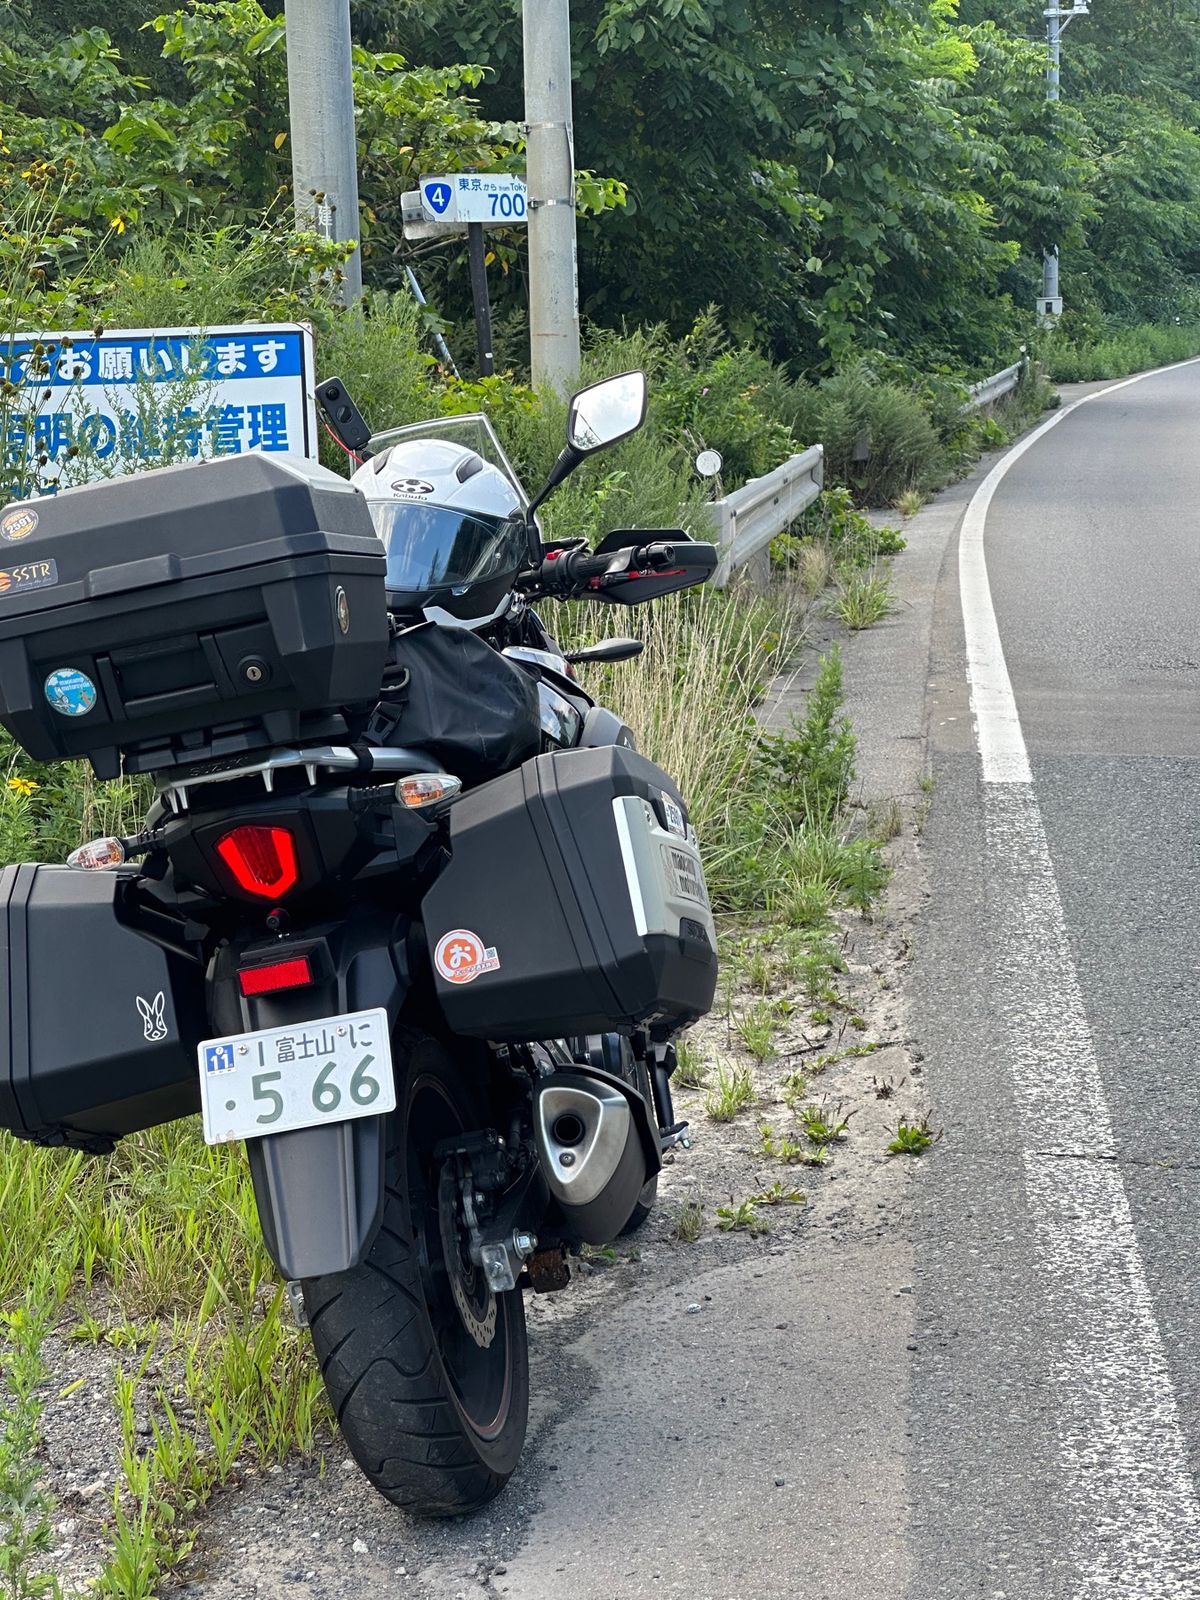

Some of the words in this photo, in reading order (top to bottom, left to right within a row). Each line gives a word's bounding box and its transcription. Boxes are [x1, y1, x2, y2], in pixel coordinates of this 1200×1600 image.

[432, 187, 445, 207] 4
[510, 182, 527, 193] Toky
[7, 515, 32, 534] 2591
[12, 563, 50, 582] SSTR
[450, 943, 472, 968] お
[210, 1053, 229, 1070] 11
